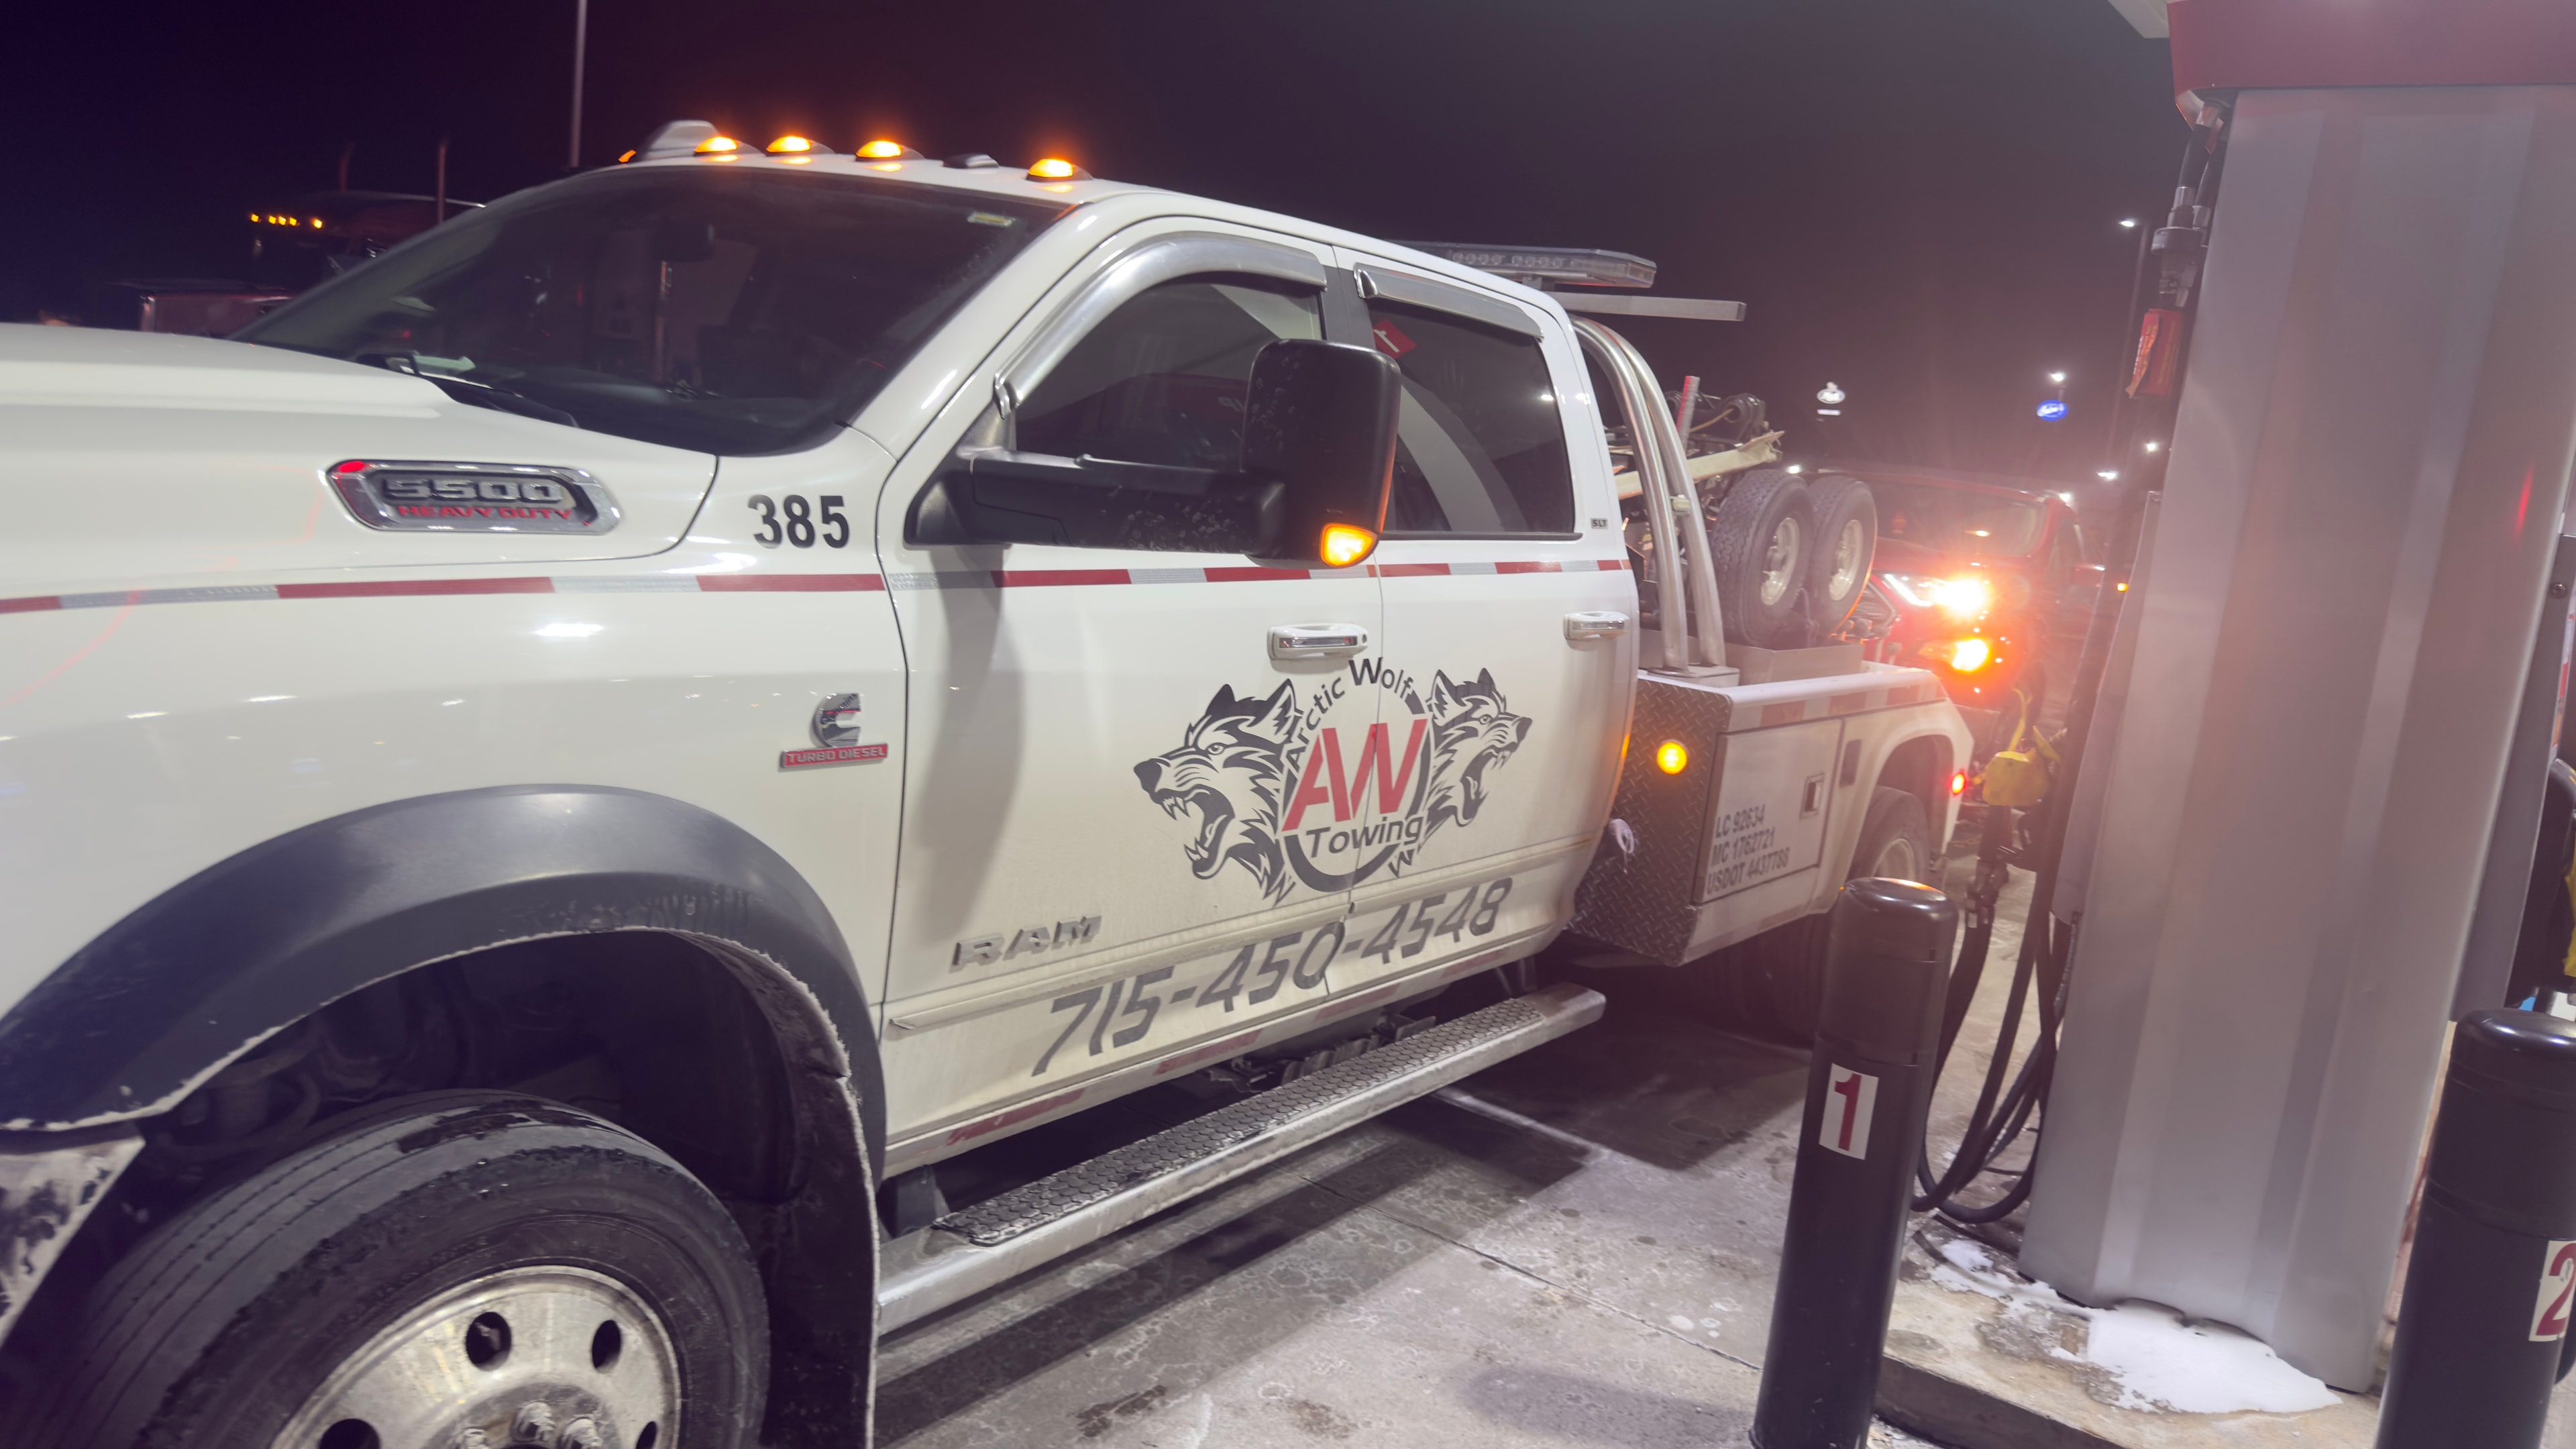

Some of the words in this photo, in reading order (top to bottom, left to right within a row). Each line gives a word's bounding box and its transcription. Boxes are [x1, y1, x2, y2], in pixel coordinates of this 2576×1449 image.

[384, 478, 564, 504] 5500
[398, 505, 494, 519] HEAVY
[498, 508, 572, 520] DUTY
[747, 494, 849, 549] 385
[1592, 519, 1608, 527] SLT
[1286, 677, 1346, 772] Arctic
[1348, 657, 1414, 699] Wolf
[788, 751, 835, 763] TURBO
[839, 747, 886, 759] DIESEL
[1282, 718, 1428, 832] AW
[1306, 816, 1424, 859] Towing
[1715, 814, 1731, 839] LC
[1711, 841, 1729, 867] MC
[1707, 862, 1746, 895] USDOT
[950, 914, 1102, 973] RAM
[1031, 877, 1513, 1077] 715-450-4548
[1834, 1073, 1862, 1152] 1
[2535, 1242, 2576, 1336] 2
